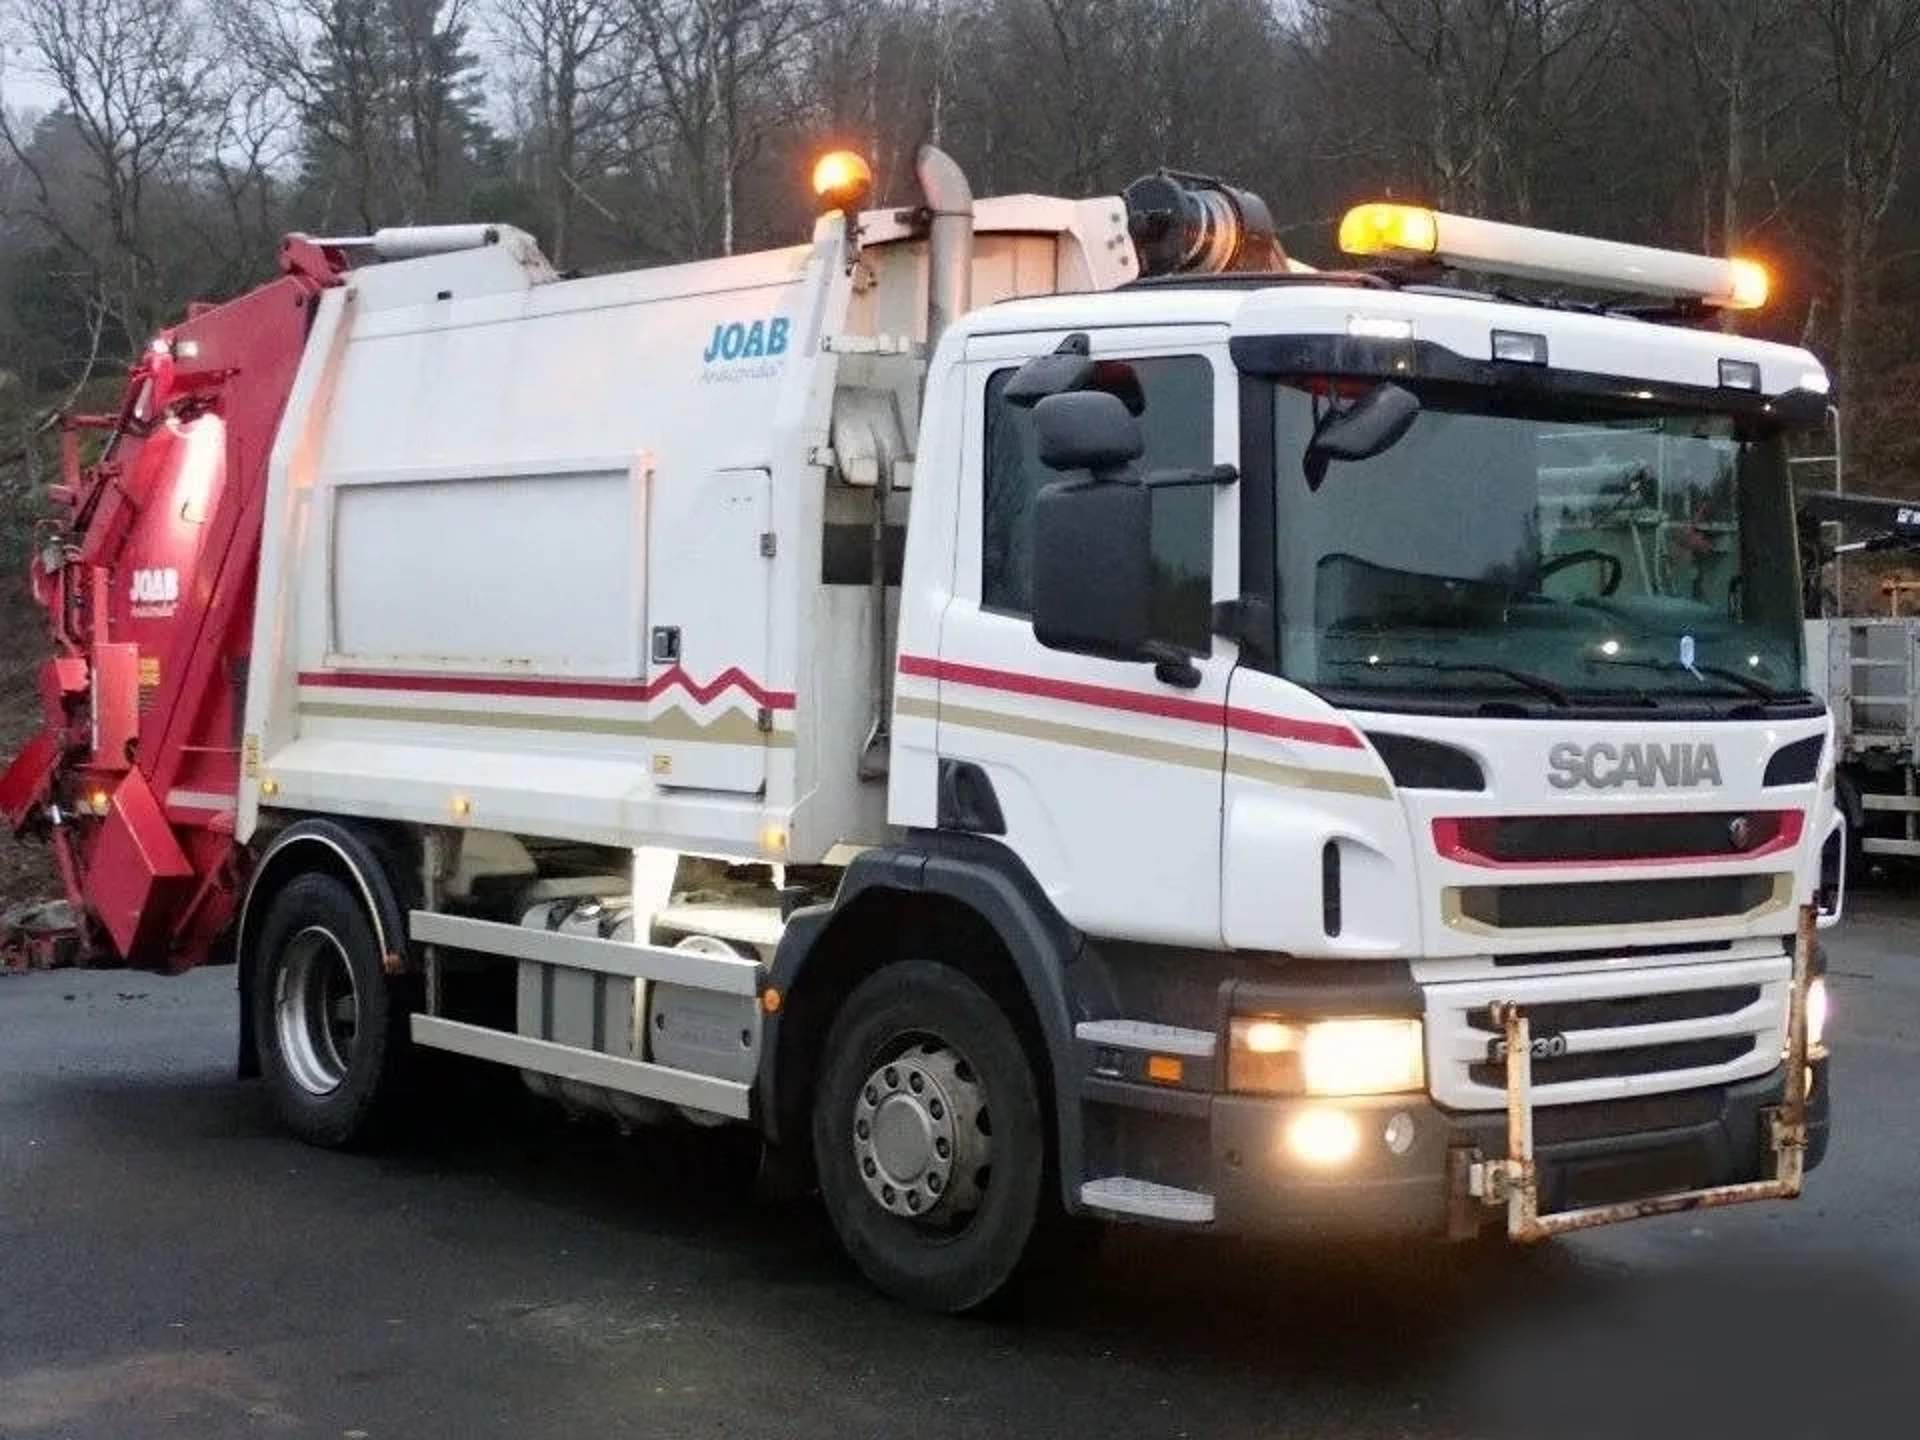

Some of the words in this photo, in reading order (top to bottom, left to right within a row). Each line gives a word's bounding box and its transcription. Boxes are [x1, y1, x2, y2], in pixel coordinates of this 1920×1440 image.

[704, 317, 789, 362] JOAB
[130, 568, 178, 602] JOAB
[1547, 742, 1723, 788] SCANIA
